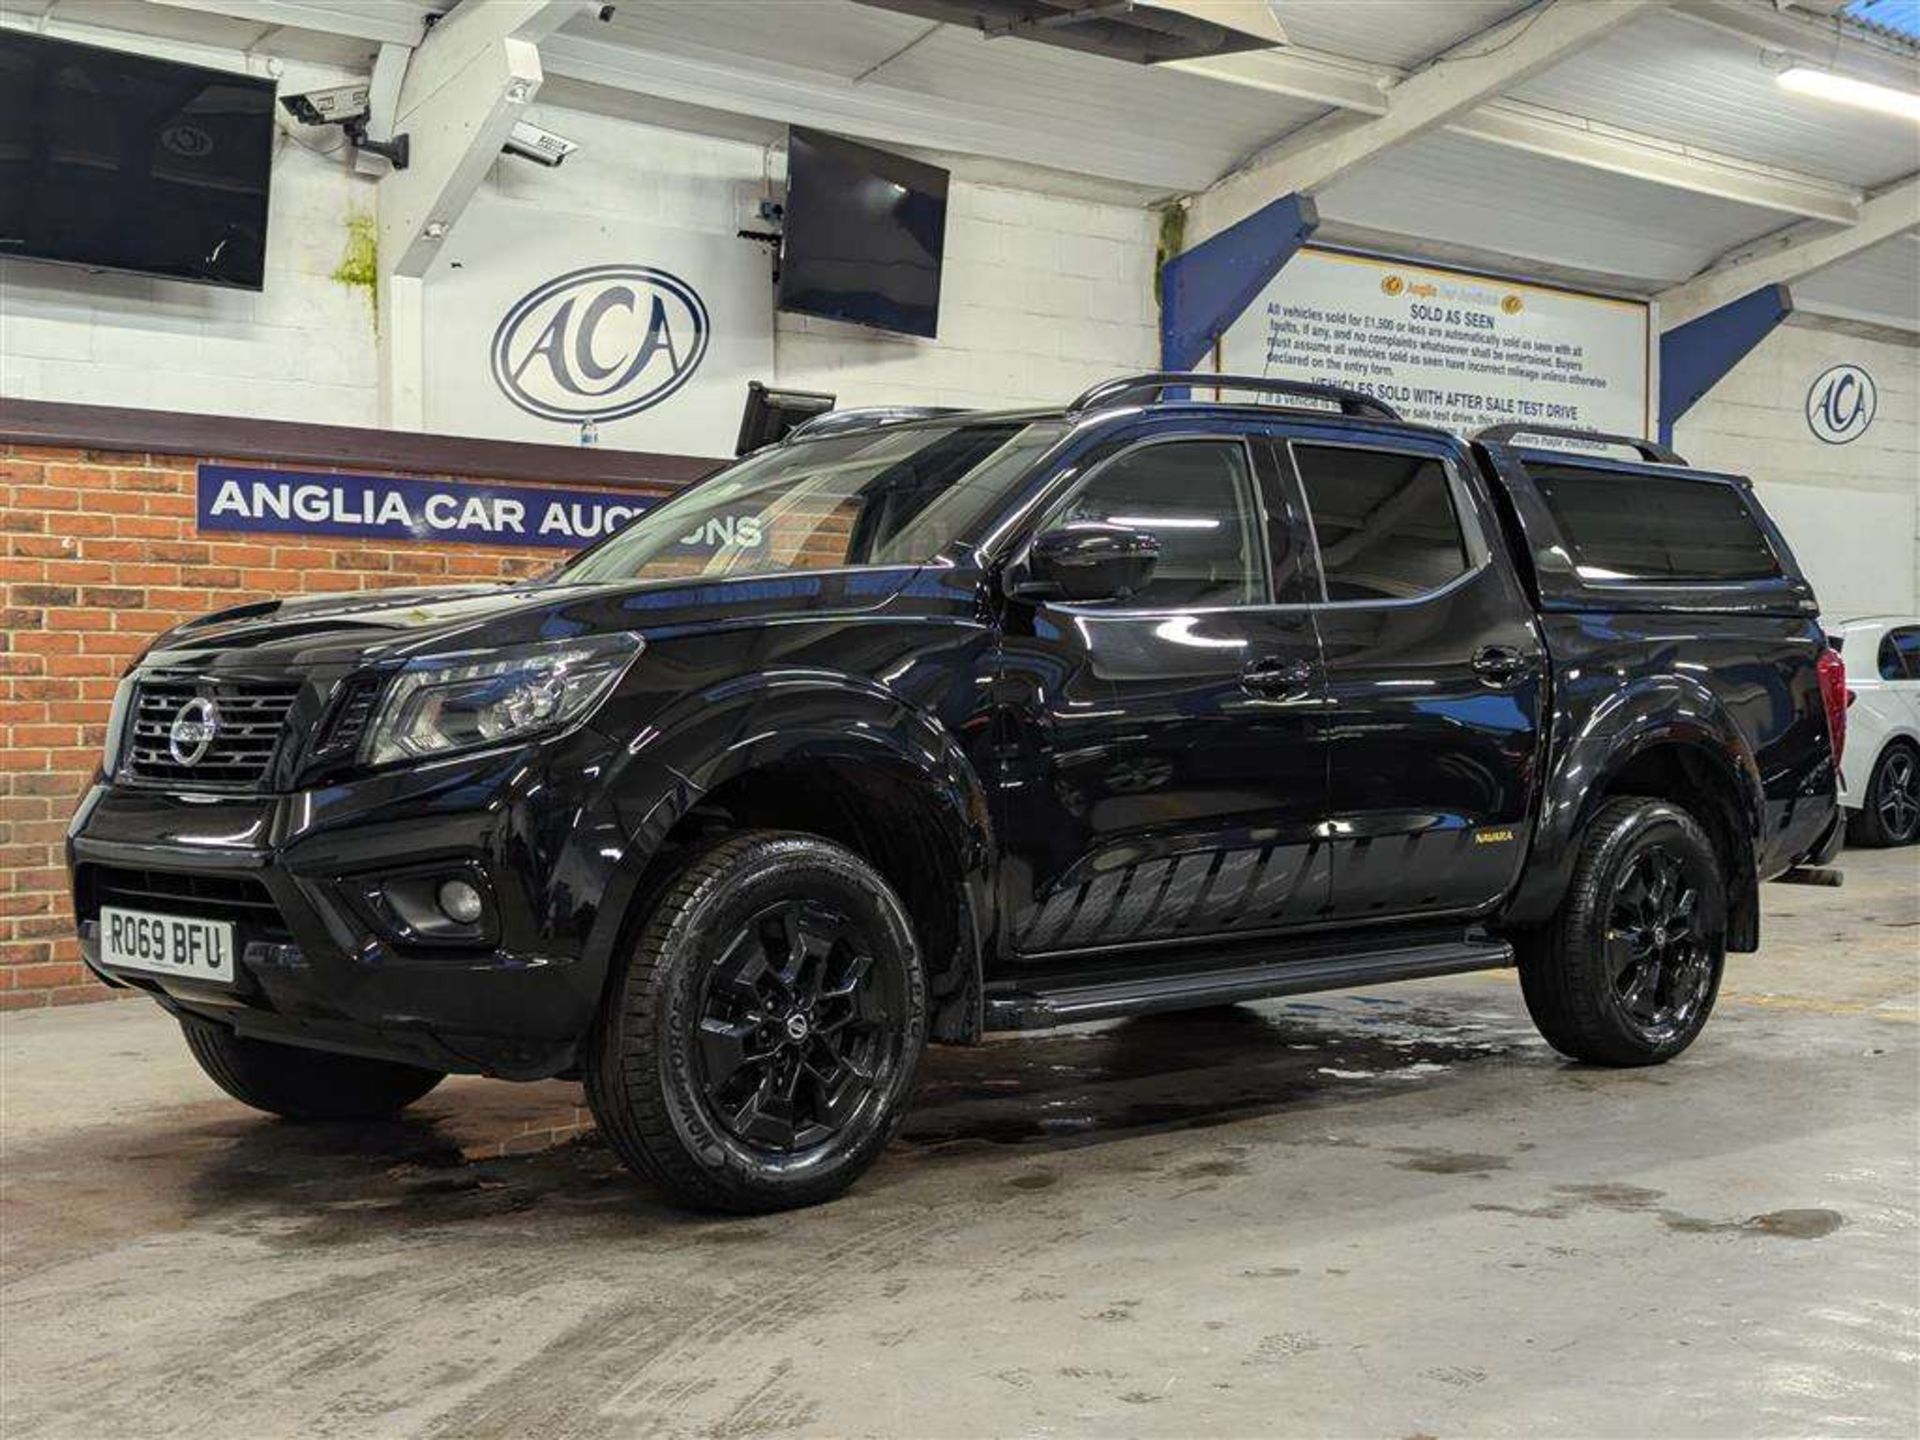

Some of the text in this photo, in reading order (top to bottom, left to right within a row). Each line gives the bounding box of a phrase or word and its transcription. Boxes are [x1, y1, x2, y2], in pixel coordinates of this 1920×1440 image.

[1267, 302, 1281, 315] All
[1282, 306, 1322, 321] vehicles
[1325, 311, 1346, 324] sold
[1349, 314, 1362, 327] for
[1396, 321, 1406, 332] or
[1408, 321, 1426, 334] less
[1445, 329, 1500, 348] automatically
[1502, 336, 1520, 348] sold
[1410, 304, 1495, 329] SOLD AS SEEN
[512, 285, 681, 396] ACA
[1293, 339, 1332, 354] assume
[1333, 344, 1346, 355] all
[1348, 345, 1387, 360] vehicles
[1388, 350, 1408, 363] sold
[1409, 354, 1420, 365] as
[1422, 356, 1444, 367] seen
[1467, 359, 1506, 375] incorrect
[1303, 323, 1310, 335] if
[1334, 329, 1351, 341] and
[1354, 332, 1366, 343] no
[1368, 333, 1418, 350] complaints
[1420, 341, 1469, 355] whatsoever
[1471, 345, 1491, 359] shall
[1267, 350, 1309, 366] declared
[1311, 357, 1324, 368] on
[1326, 357, 1341, 370] the
[1344, 360, 1369, 378] entry
[1377, 384, 1410, 401] SOLD
[1413, 388, 1442, 404] WITH
[1446, 391, 1482, 410] AFTER
[1485, 396, 1514, 413] SALE
[1518, 401, 1546, 417] TEST
[1546, 404, 1578, 420] DRIVE
[210, 480, 763, 548] ANGLIA CAR AUCNS
[172, 921, 222, 968] BFU
